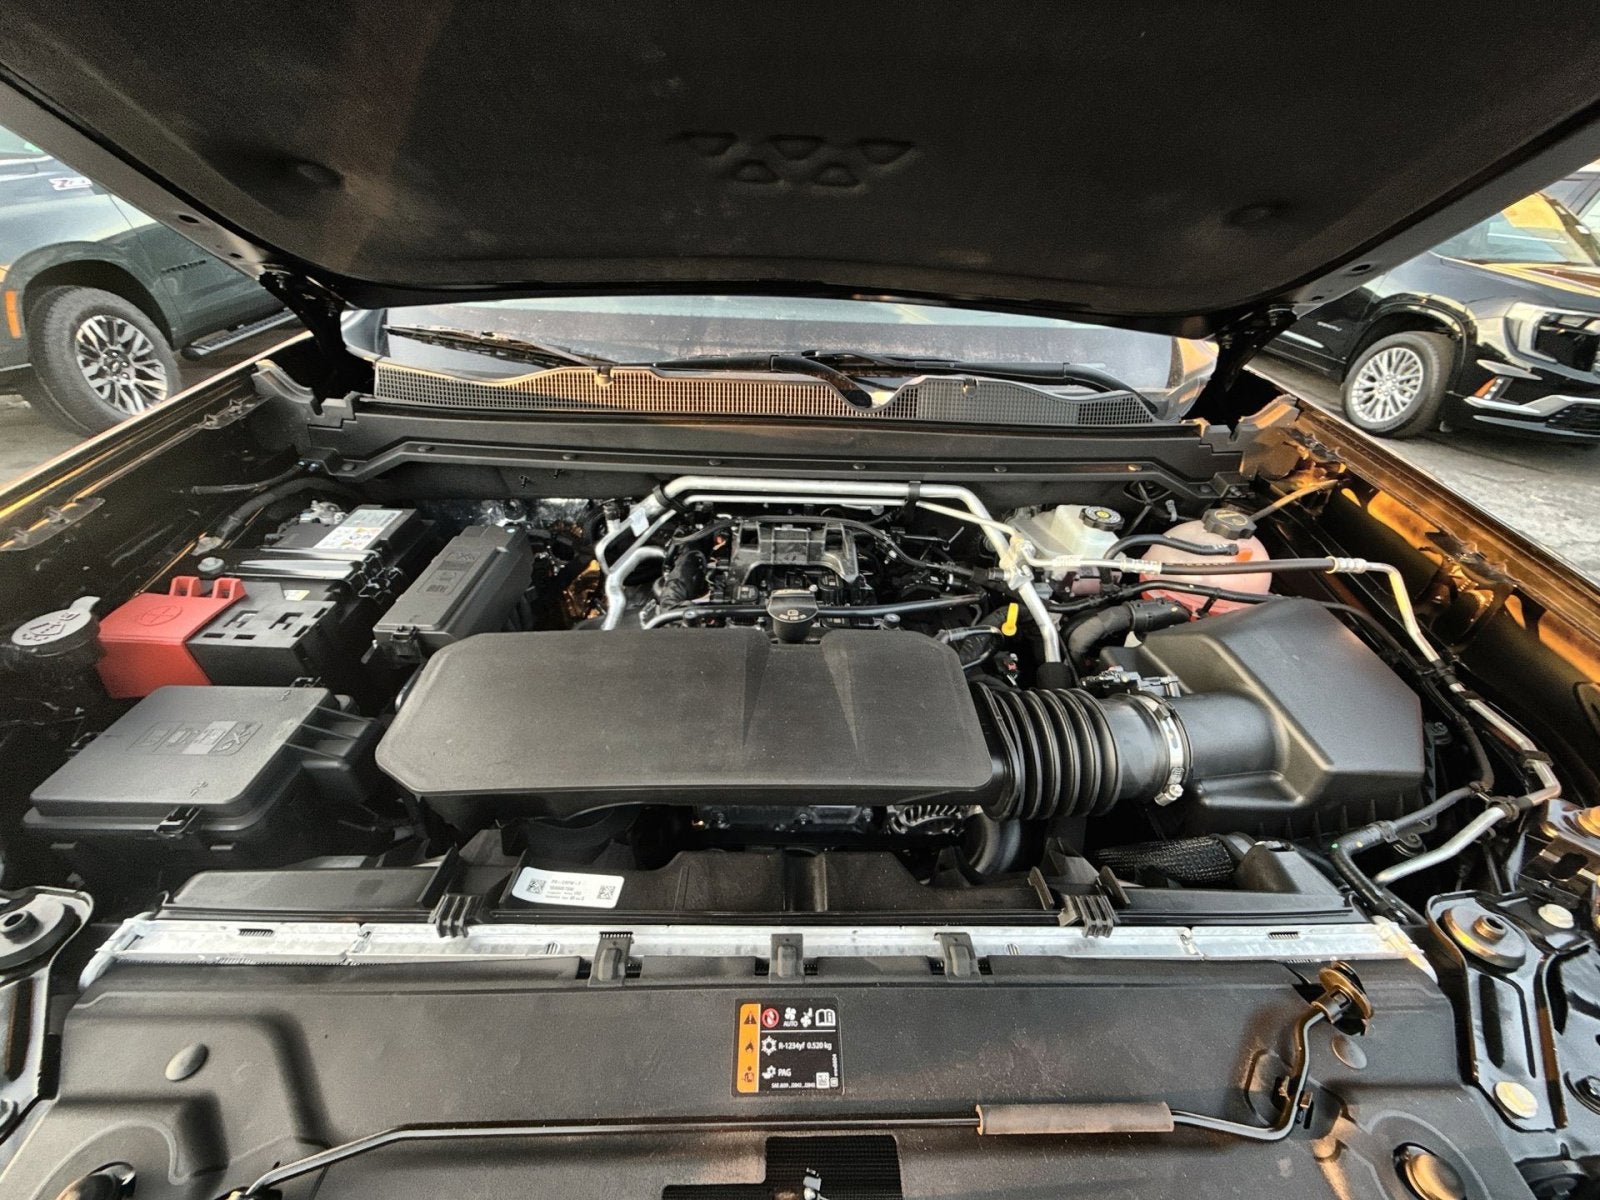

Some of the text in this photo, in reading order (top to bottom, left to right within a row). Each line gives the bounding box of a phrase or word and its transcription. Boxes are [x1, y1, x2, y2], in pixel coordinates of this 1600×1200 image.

[778, 1041, 805, 1051] R-1234yf
[824, 1041, 832, 1051] kg
[777, 1068, 792, 1077] PAG
